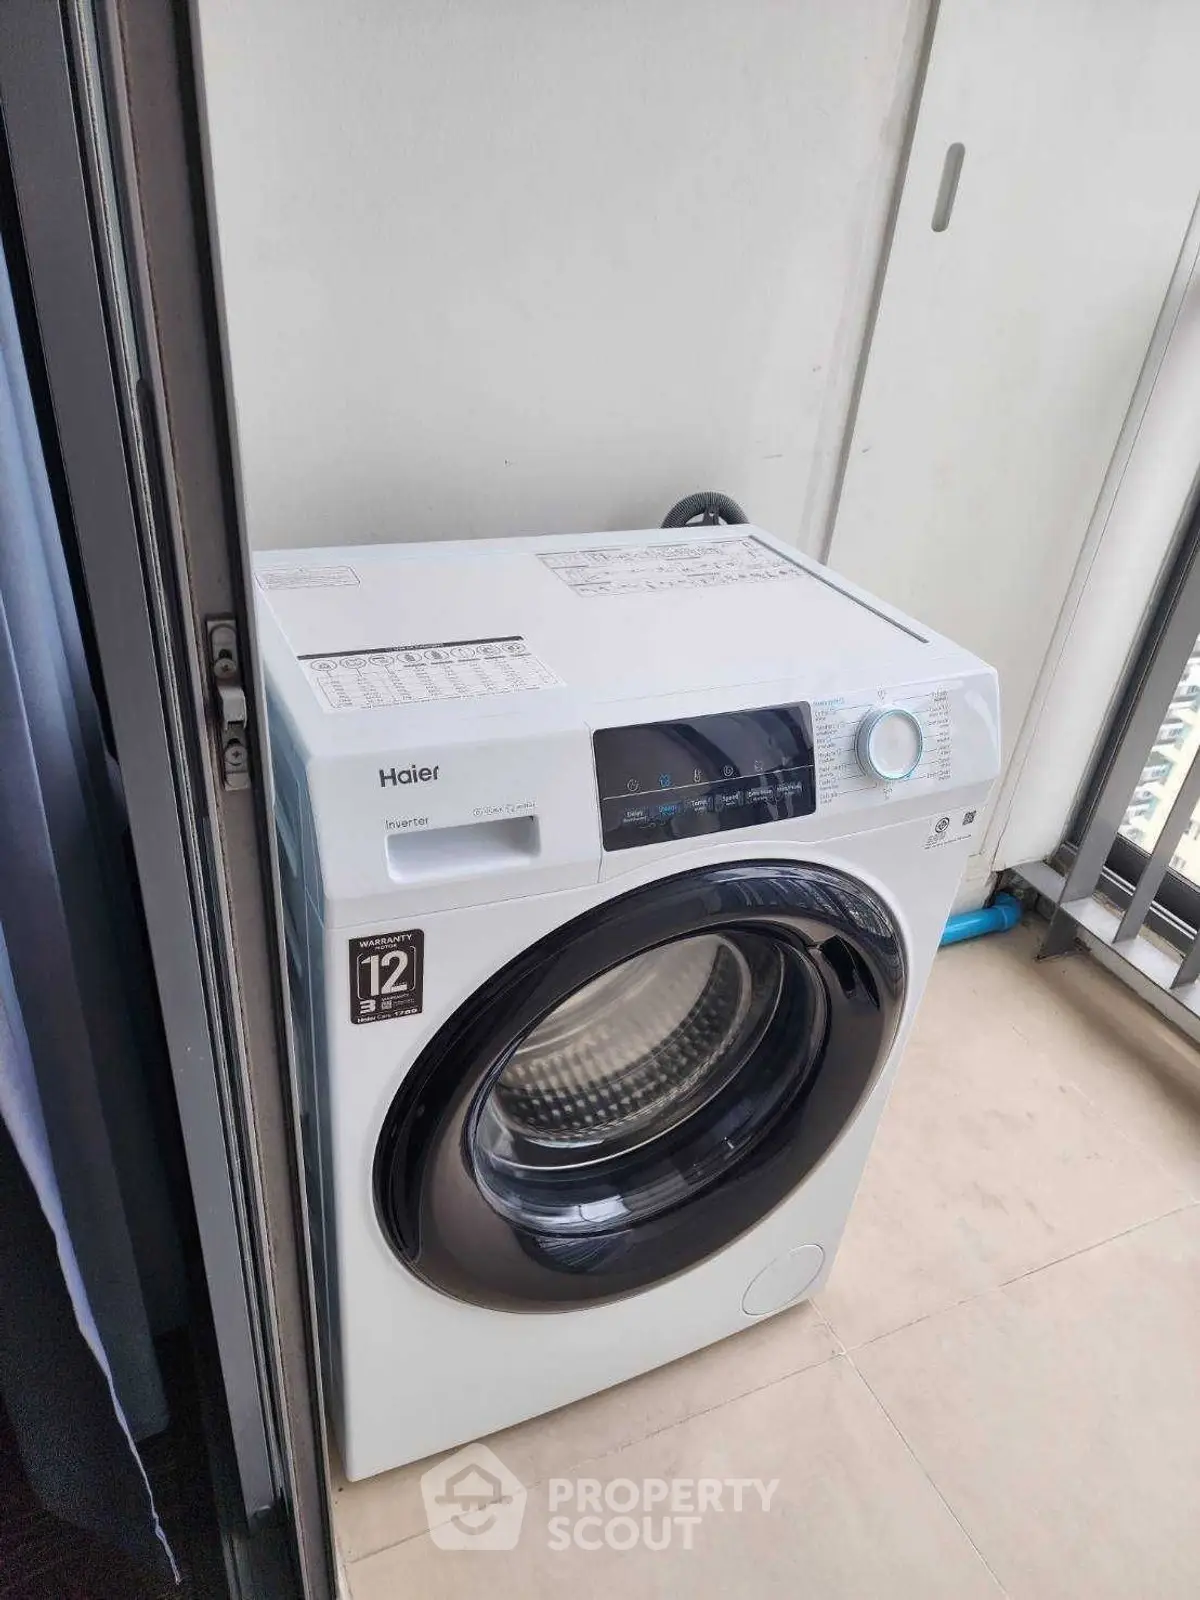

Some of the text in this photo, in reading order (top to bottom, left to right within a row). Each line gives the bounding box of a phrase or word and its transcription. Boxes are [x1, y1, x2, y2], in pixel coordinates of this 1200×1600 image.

[379, 765, 439, 787] Haier
[385, 816, 429, 830] Inverter
[360, 934, 412, 947] WARRANTY
[361, 950, 408, 996] 12
